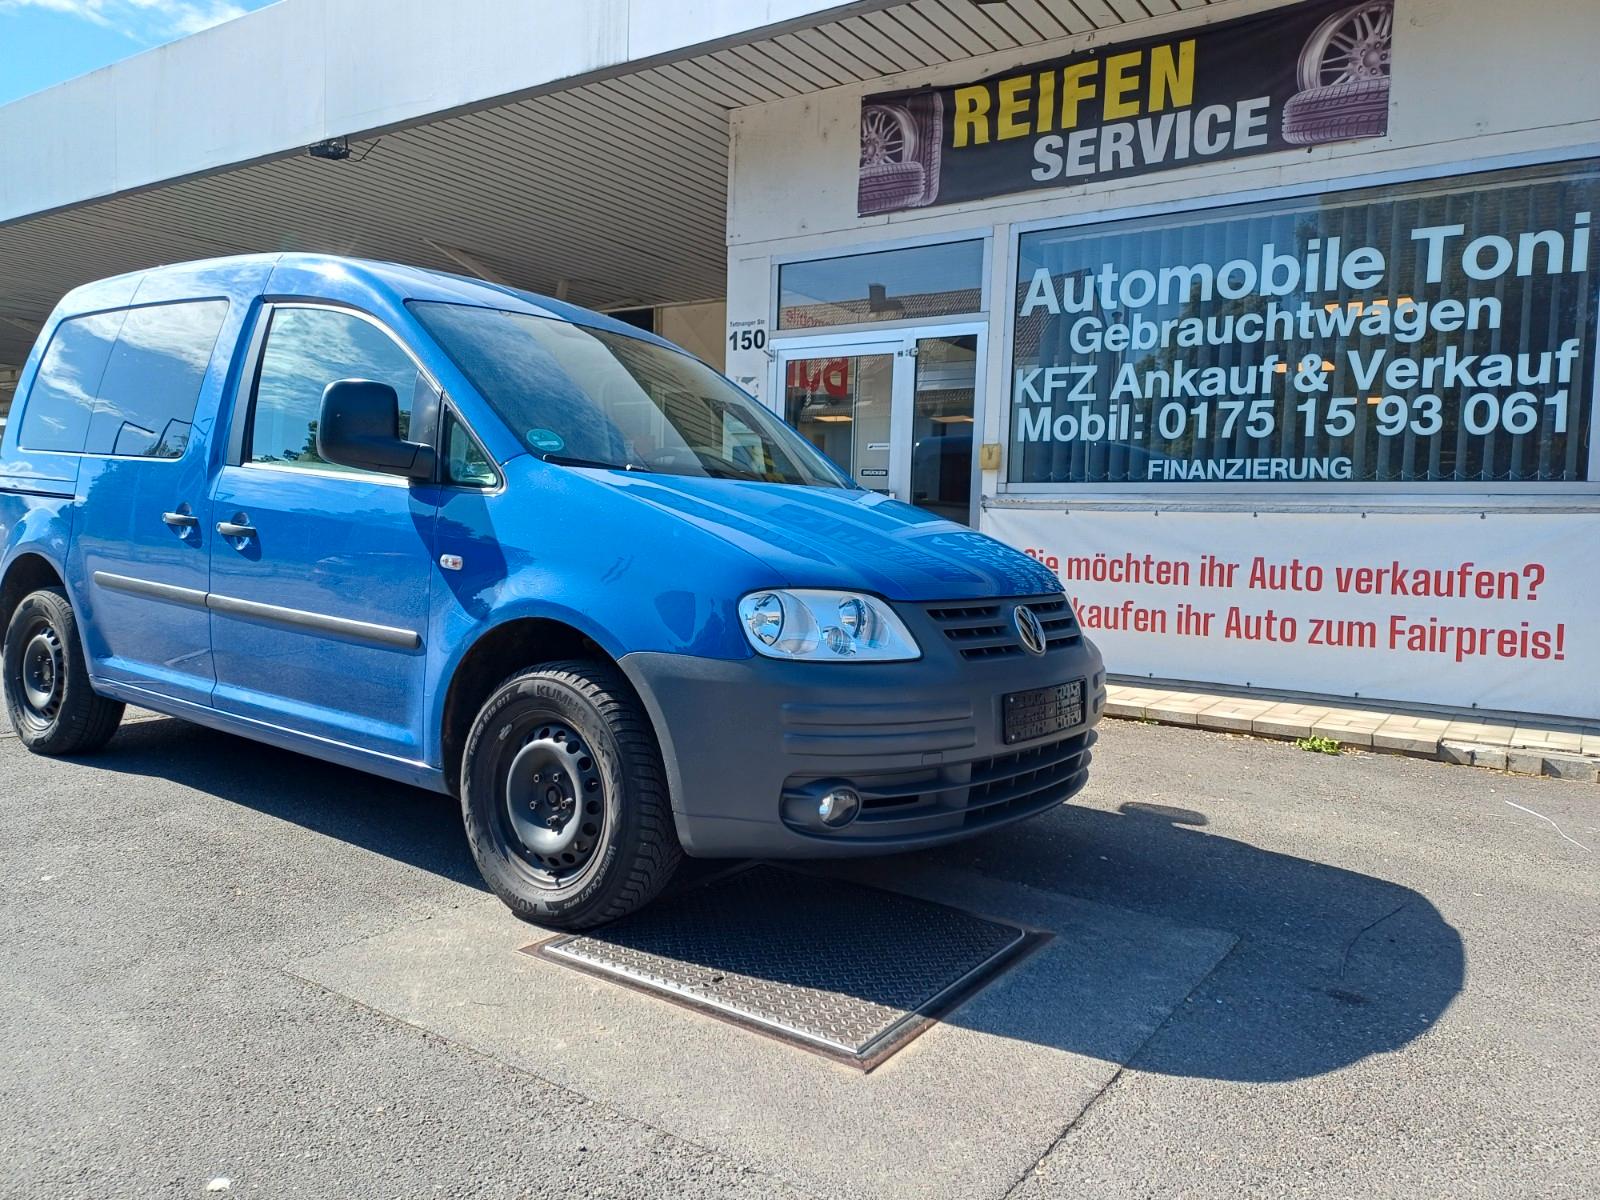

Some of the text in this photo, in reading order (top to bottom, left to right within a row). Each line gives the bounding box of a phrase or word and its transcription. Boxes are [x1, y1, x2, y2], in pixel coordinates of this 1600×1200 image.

[952, 39, 1196, 148] REIFEN
[1031, 96, 1271, 181] SERVICE
[1019, 211, 1591, 317] Automobile Toni
[728, 329, 766, 351] 150
[1070, 297, 1502, 354] Gebrauchtwagen
[1014, 338, 1580, 403] KFZ Ankauf & Verkauf
[1017, 390, 1568, 442] Mobil: 0175 15 93 061
[1147, 457, 1352, 480] FINANZIERUNG
[1067, 553, 1190, 586] möchten
[1199, 556, 1240, 588] ihr
[1249, 557, 1323, 592] Auto
[1336, 561, 1546, 601] verkaufen?
[1176, 604, 1215, 637] ihr
[1225, 607, 1297, 643] Auto
[1308, 618, 1377, 648] zum
[1388, 615, 1565, 662] Fairpreis!
